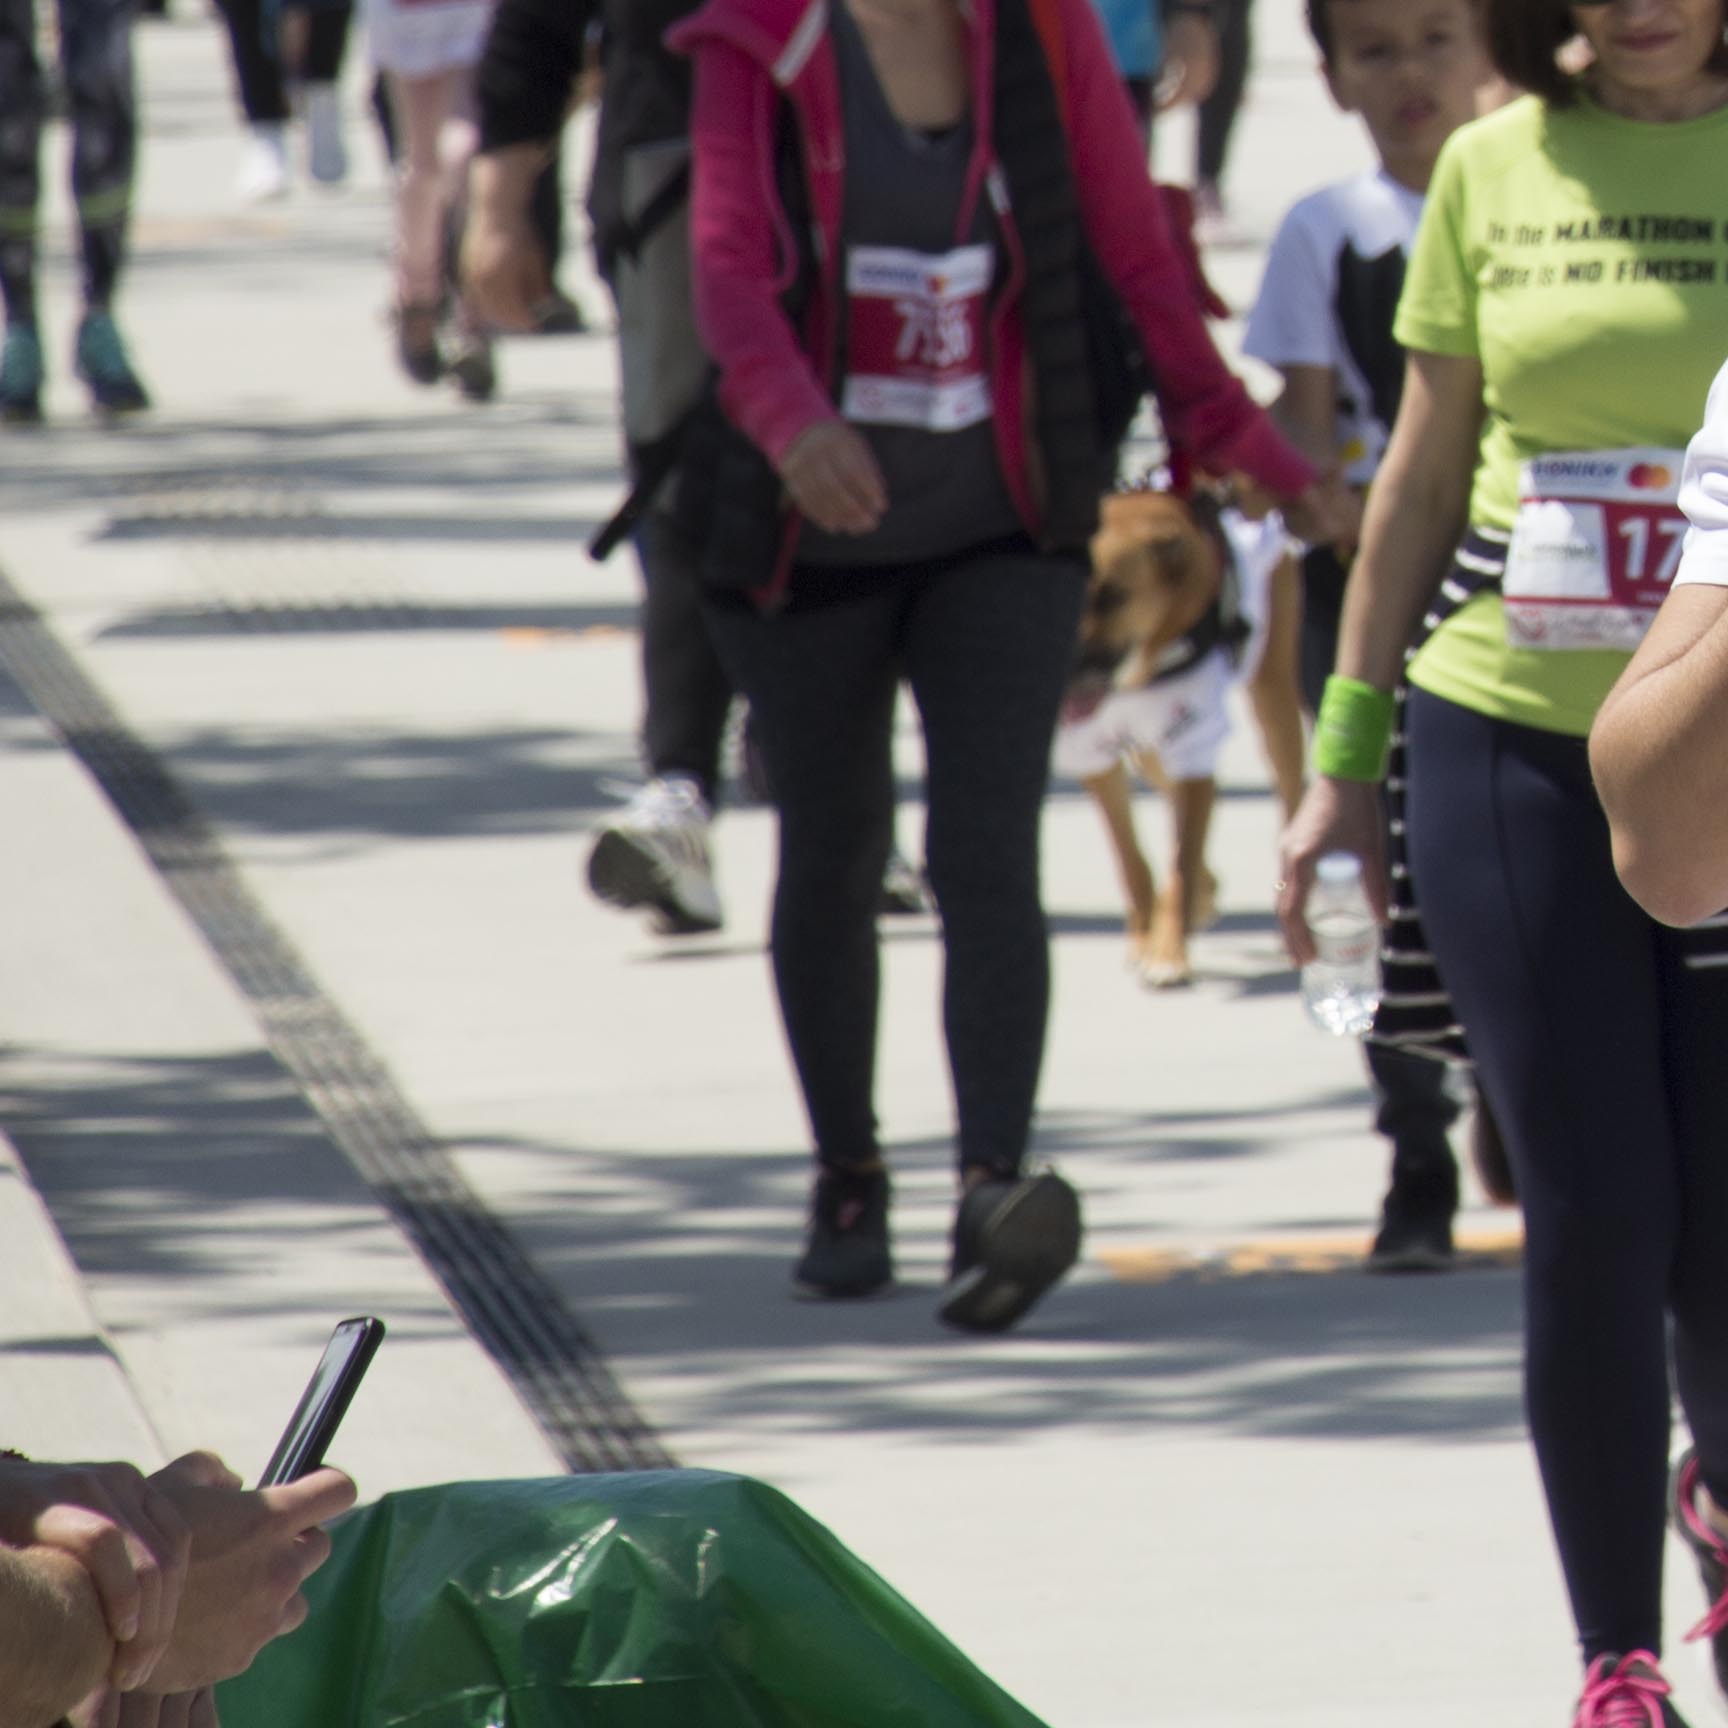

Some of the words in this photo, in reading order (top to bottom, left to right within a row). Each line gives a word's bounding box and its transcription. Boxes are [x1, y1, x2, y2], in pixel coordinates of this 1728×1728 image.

[1553, 217, 1712, 243] MARATHON
[1563, 261, 1600, 284] NO
[1613, 258, 1715, 284] FINISH
